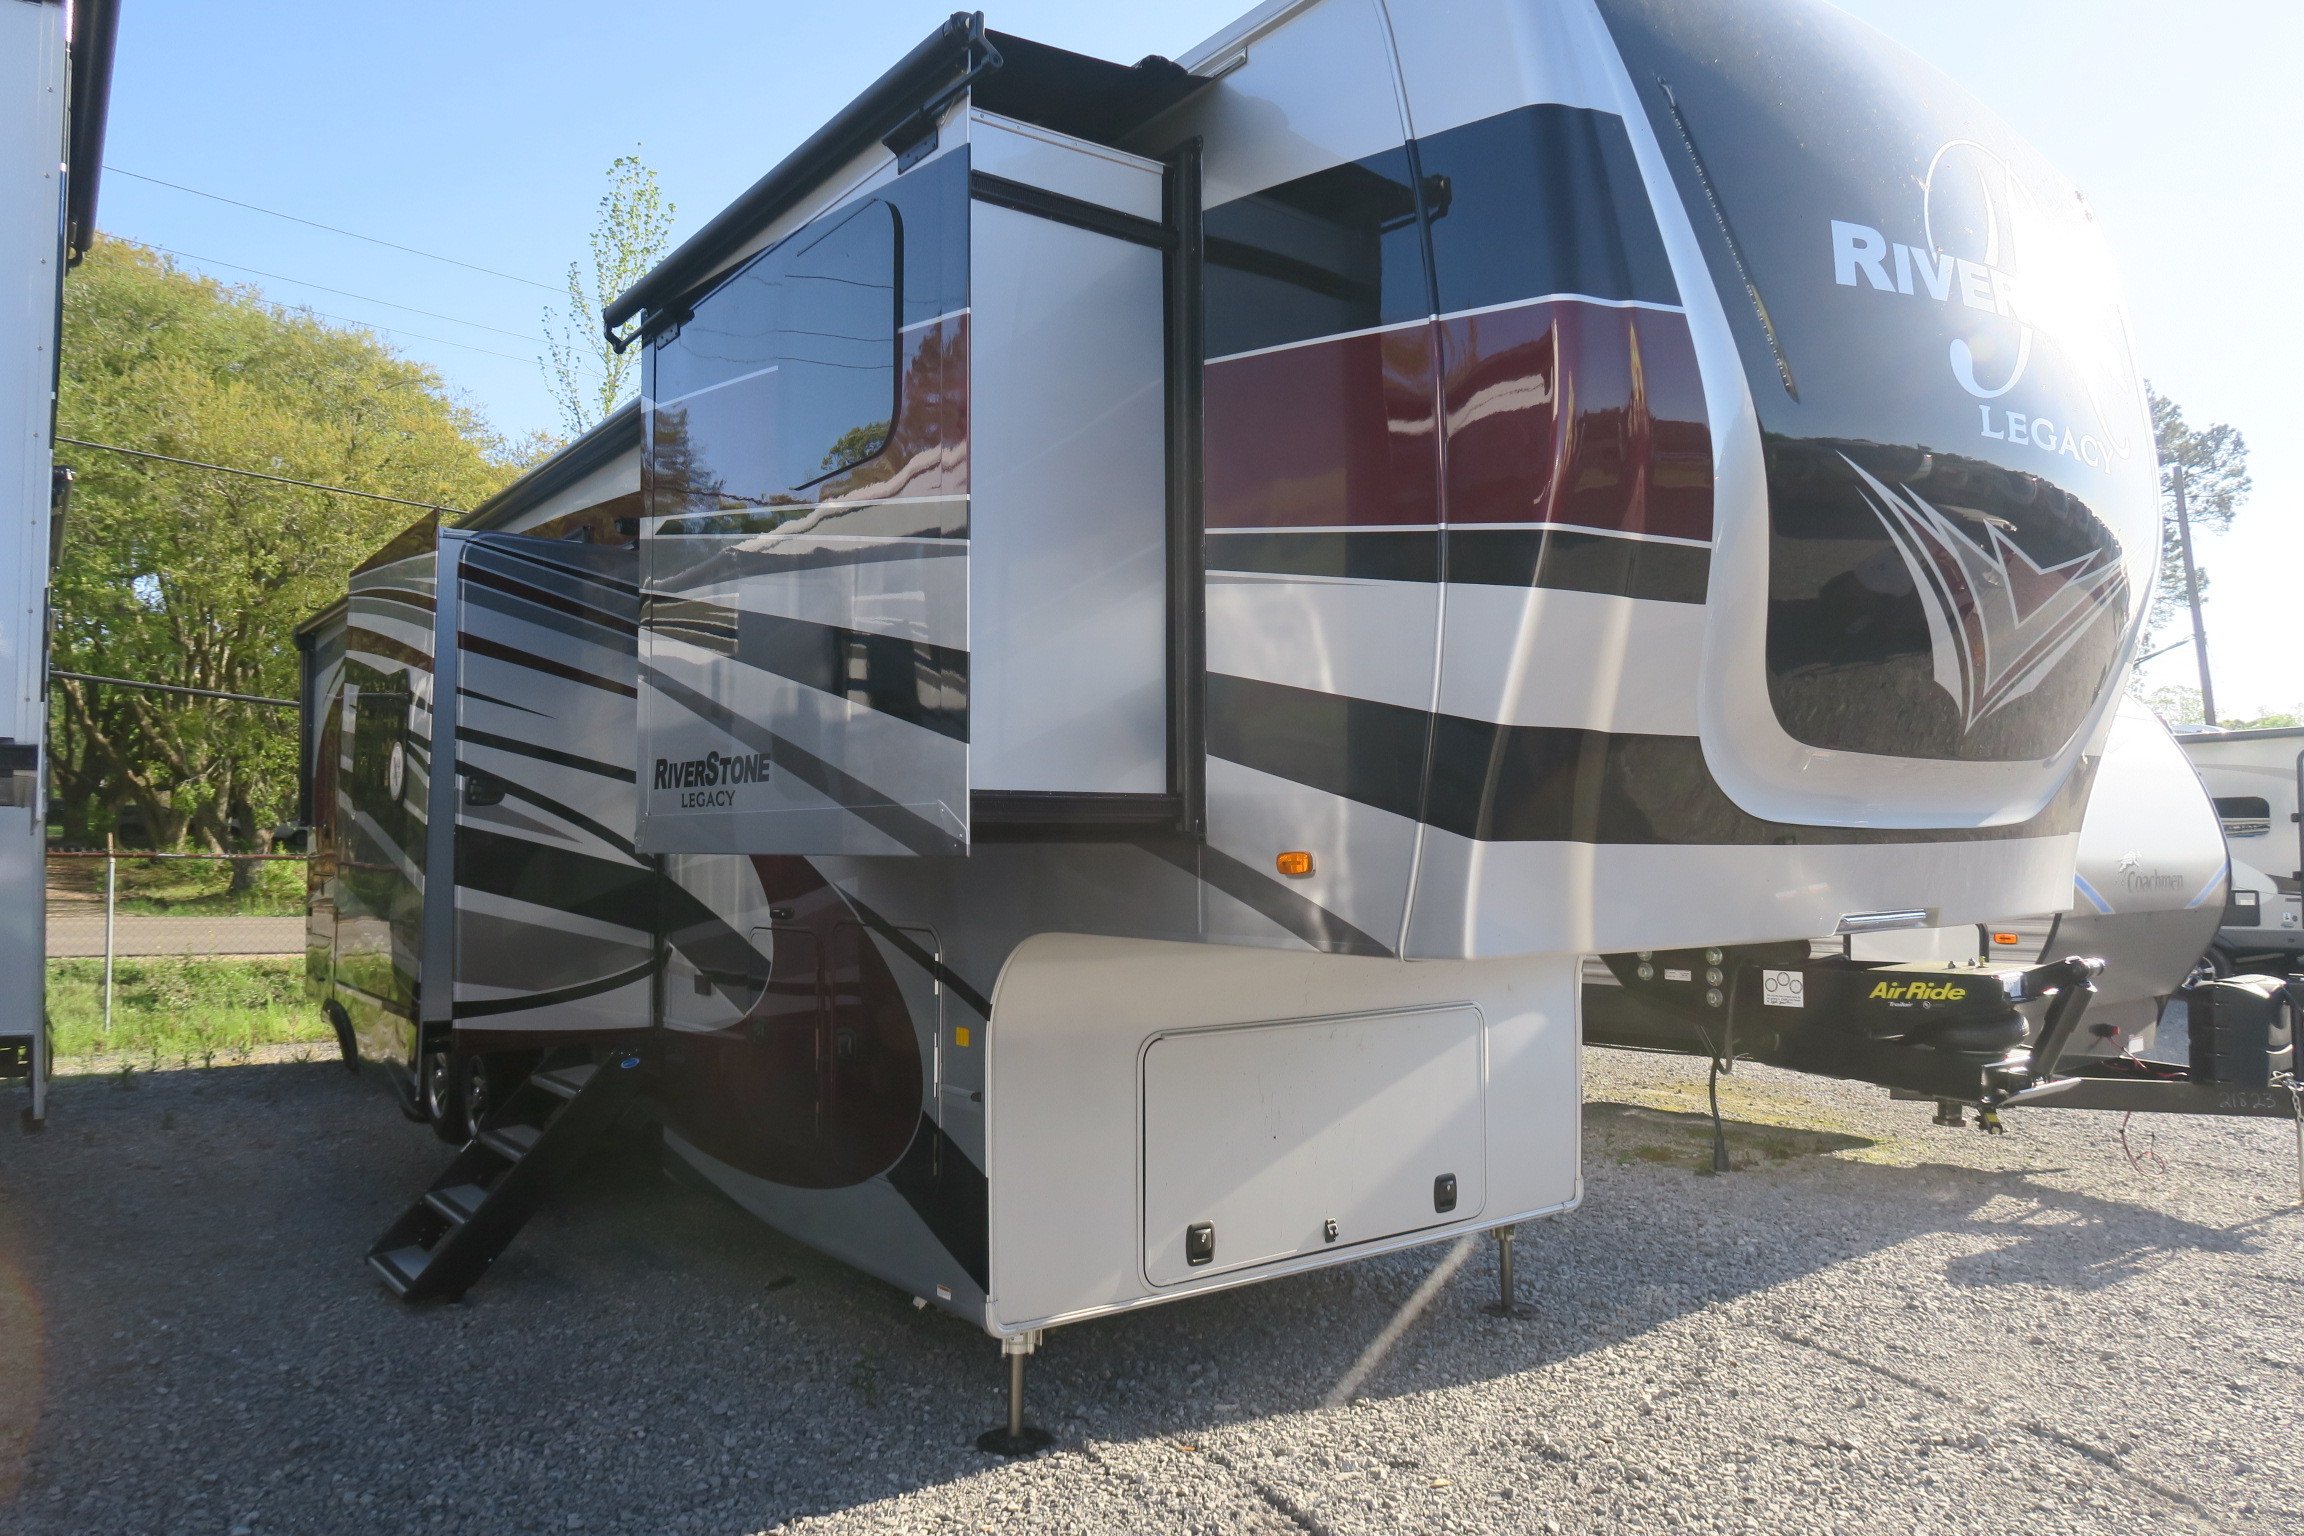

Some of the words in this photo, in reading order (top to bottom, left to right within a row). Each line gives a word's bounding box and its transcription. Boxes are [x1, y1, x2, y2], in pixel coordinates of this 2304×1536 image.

[1978, 404, 2116, 475] LEGACY
[681, 790, 736, 808] LEGACY
[2127, 868, 2184, 893] Coachmen
